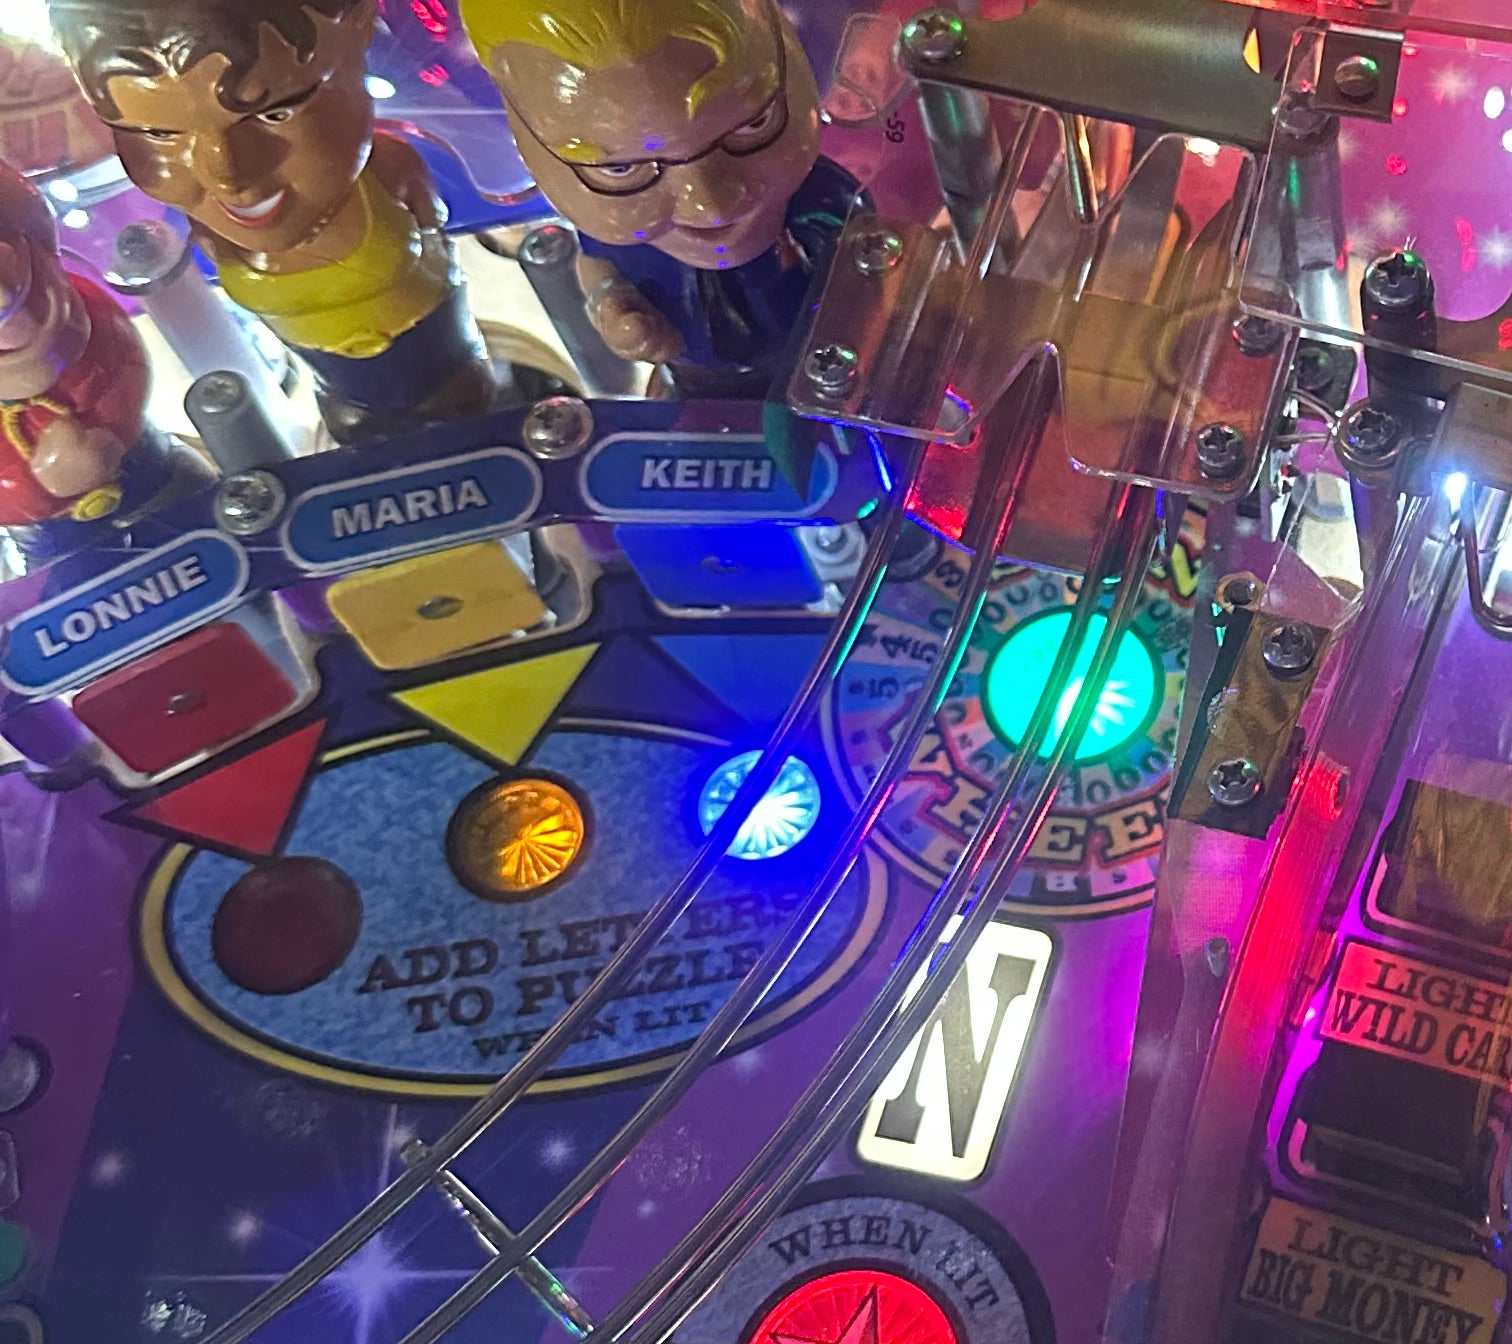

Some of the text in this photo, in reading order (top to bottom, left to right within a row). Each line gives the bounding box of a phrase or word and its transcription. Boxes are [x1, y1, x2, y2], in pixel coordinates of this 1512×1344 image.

[641, 457, 774, 490] KEITH
[330, 478, 491, 541] MARIA
[34, 552, 211, 659] LONNIE
[356, 890, 799, 993] ADD LETER
[408, 986, 493, 1033] TO
[635, 1000, 710, 1033] LIT
[1330, 988, 1438, 1054] WILD
[875, 953, 1036, 1159] N
[768, 1206, 932, 1261] WHEN
[1288, 1217, 1464, 1299] LIGHT
[1249, 1248, 1313, 1312] BIG
